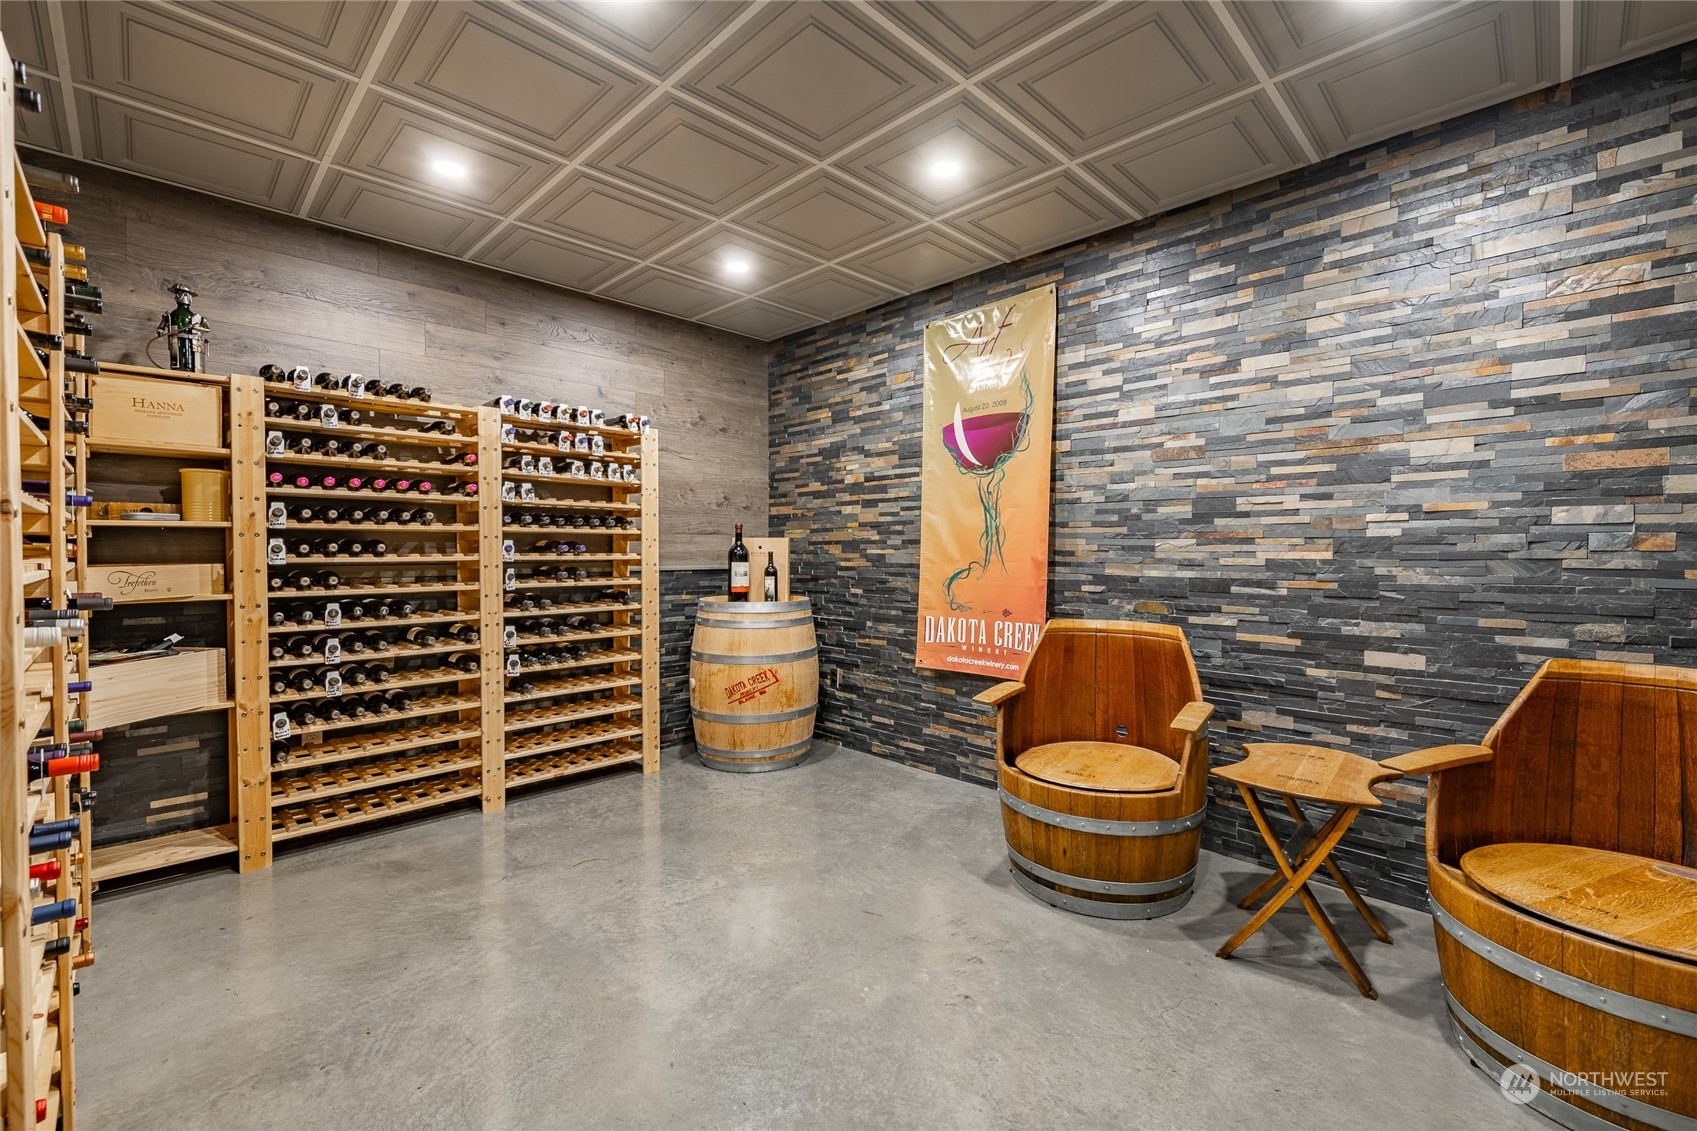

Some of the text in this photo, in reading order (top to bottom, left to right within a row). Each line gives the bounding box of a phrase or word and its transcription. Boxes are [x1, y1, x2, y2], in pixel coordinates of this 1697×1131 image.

[963, 399, 1007, 413] August 22, 2009
[107, 570, 156, 595] Trefethen
[924, 615, 1041, 653] DAKOTA CREEK
[961, 645, 1008, 656] WINERY
[946, 655, 1020, 671] dakotacreekwinery.com
[724, 670, 771, 699] DAKOTA CREEK
